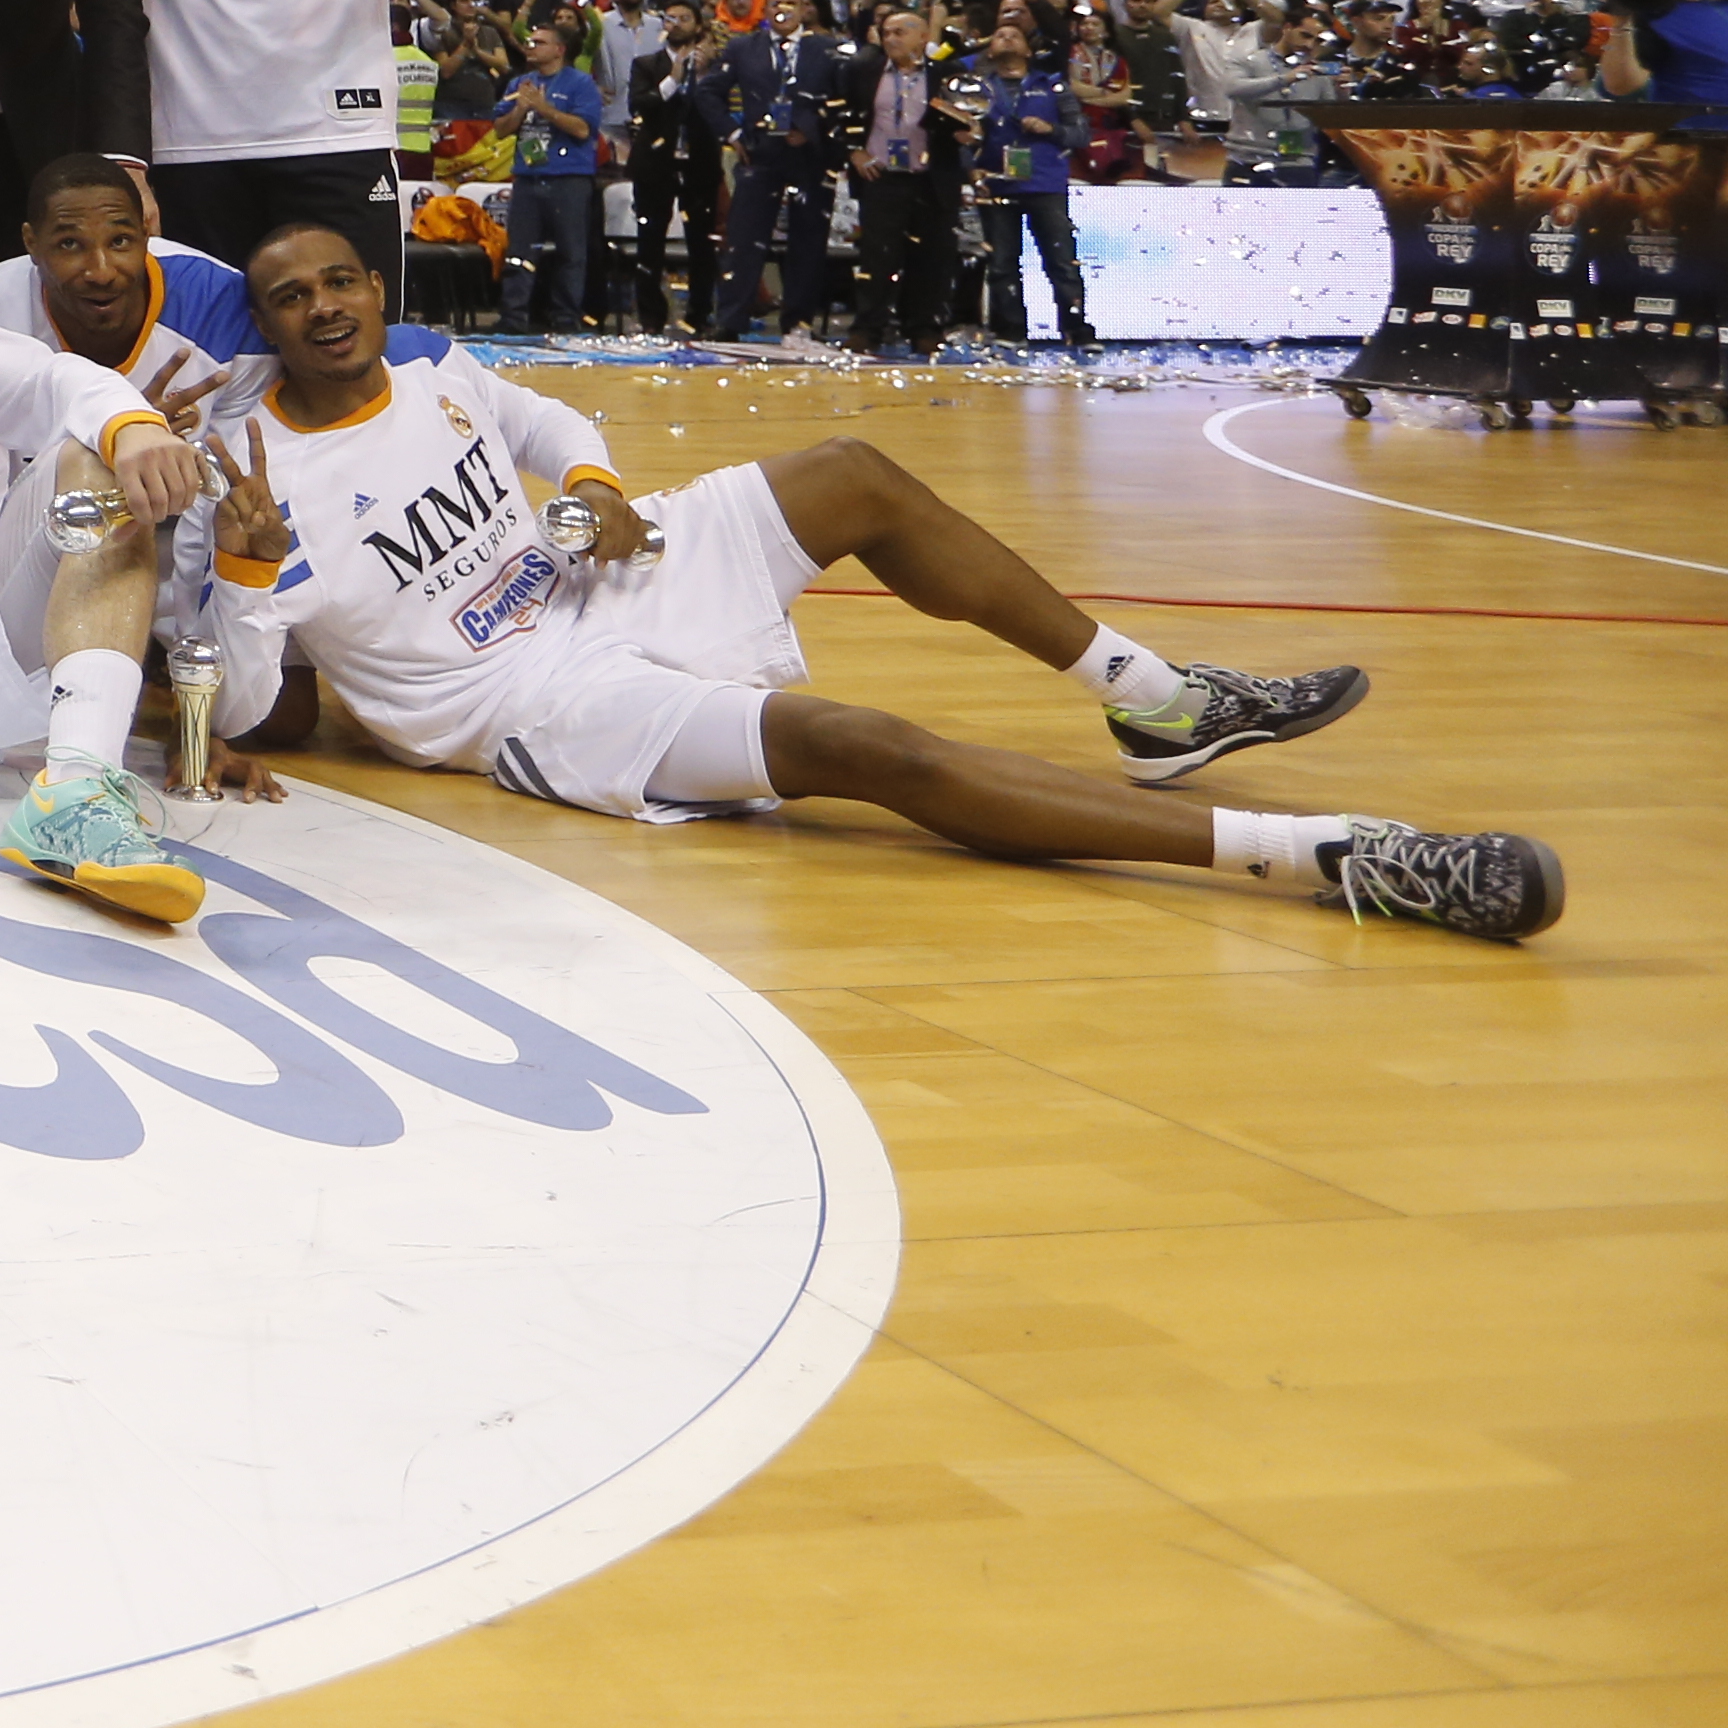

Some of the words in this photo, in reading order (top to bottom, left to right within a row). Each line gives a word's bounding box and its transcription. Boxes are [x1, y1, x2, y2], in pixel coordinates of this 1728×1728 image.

[1428, 233, 1459, 244] COPA
[1529, 243, 1560, 254] COPA
[1436, 244, 1473, 259] REY
[1536, 254, 1570, 269] REY
[354, 496, 379, 520] adidas
[361, 435, 509, 594] MMT
[424, 508, 517, 602] SEGUROS
[461, 553, 555, 643] CAMPEONES
[508, 597, 544, 626] 24
